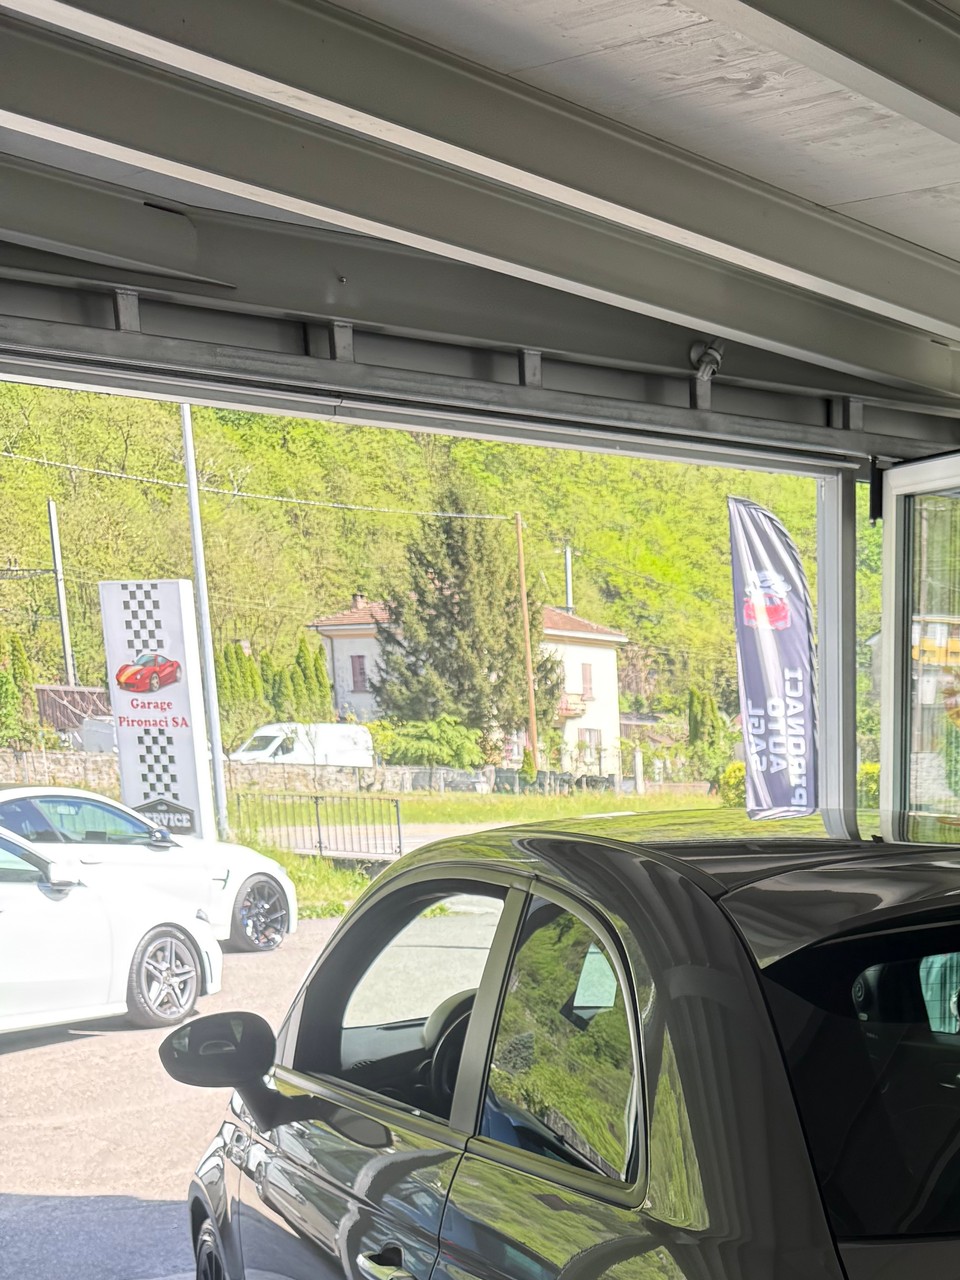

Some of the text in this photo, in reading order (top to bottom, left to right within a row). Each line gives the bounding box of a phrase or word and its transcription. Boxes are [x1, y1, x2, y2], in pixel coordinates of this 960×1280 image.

[130, 698, 173, 712] Garage
[118, 716, 189, 728] Pironaci SA
